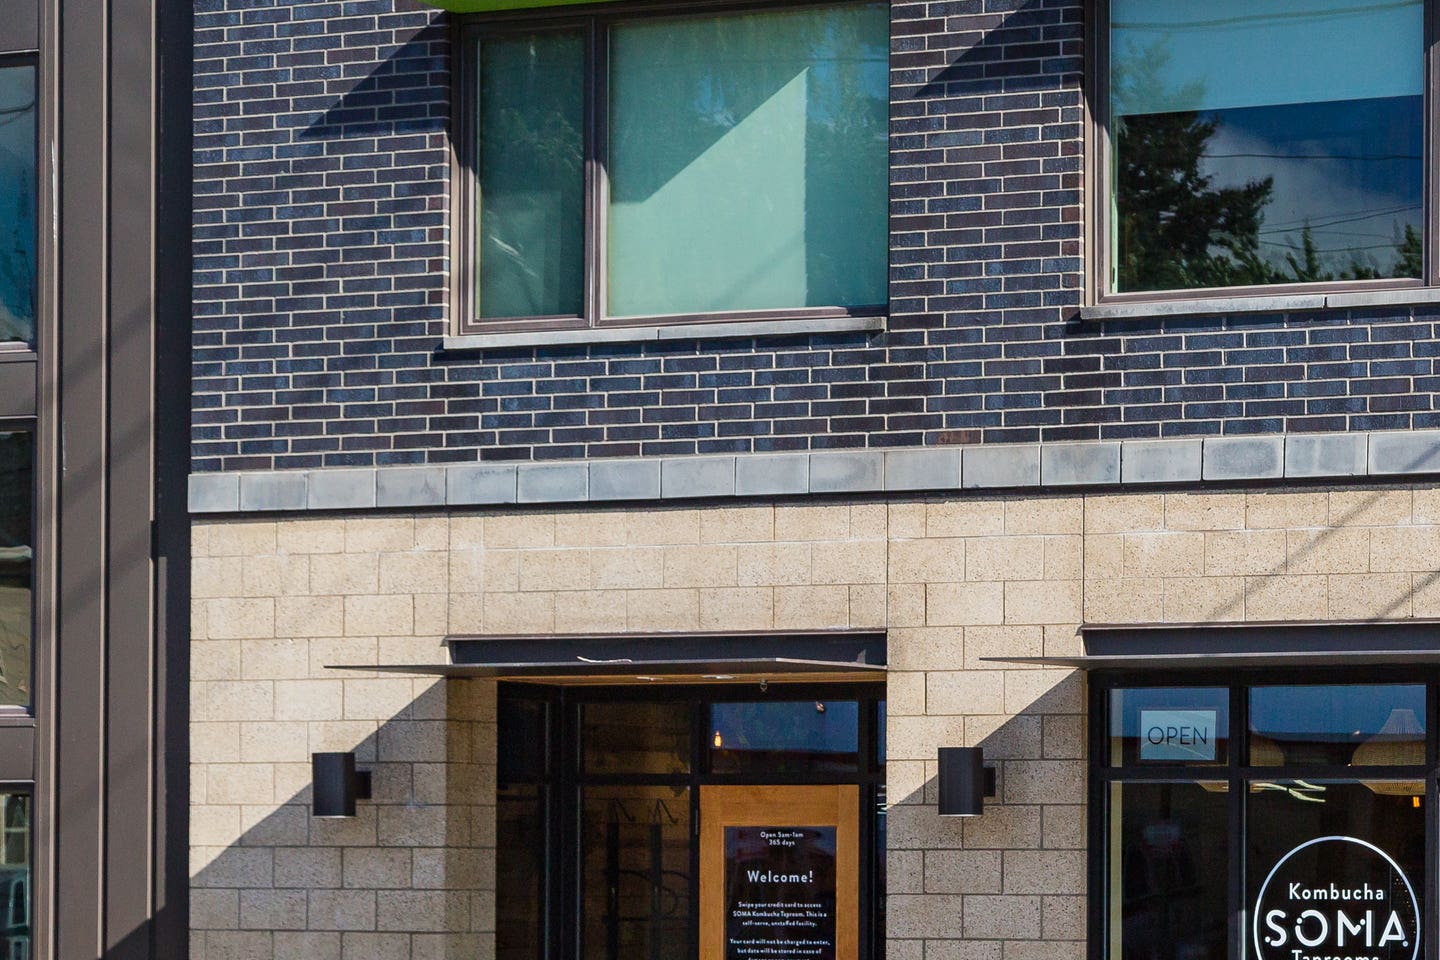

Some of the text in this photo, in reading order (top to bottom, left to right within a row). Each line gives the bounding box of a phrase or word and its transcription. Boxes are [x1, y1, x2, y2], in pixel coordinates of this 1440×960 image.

[1147, 726, 1207, 745] OPEN
[747, 870, 813, 883] Welcome!
[1289, 882, 1384, 900] Kombucha
[1264, 909, 1408, 947] SOMA
